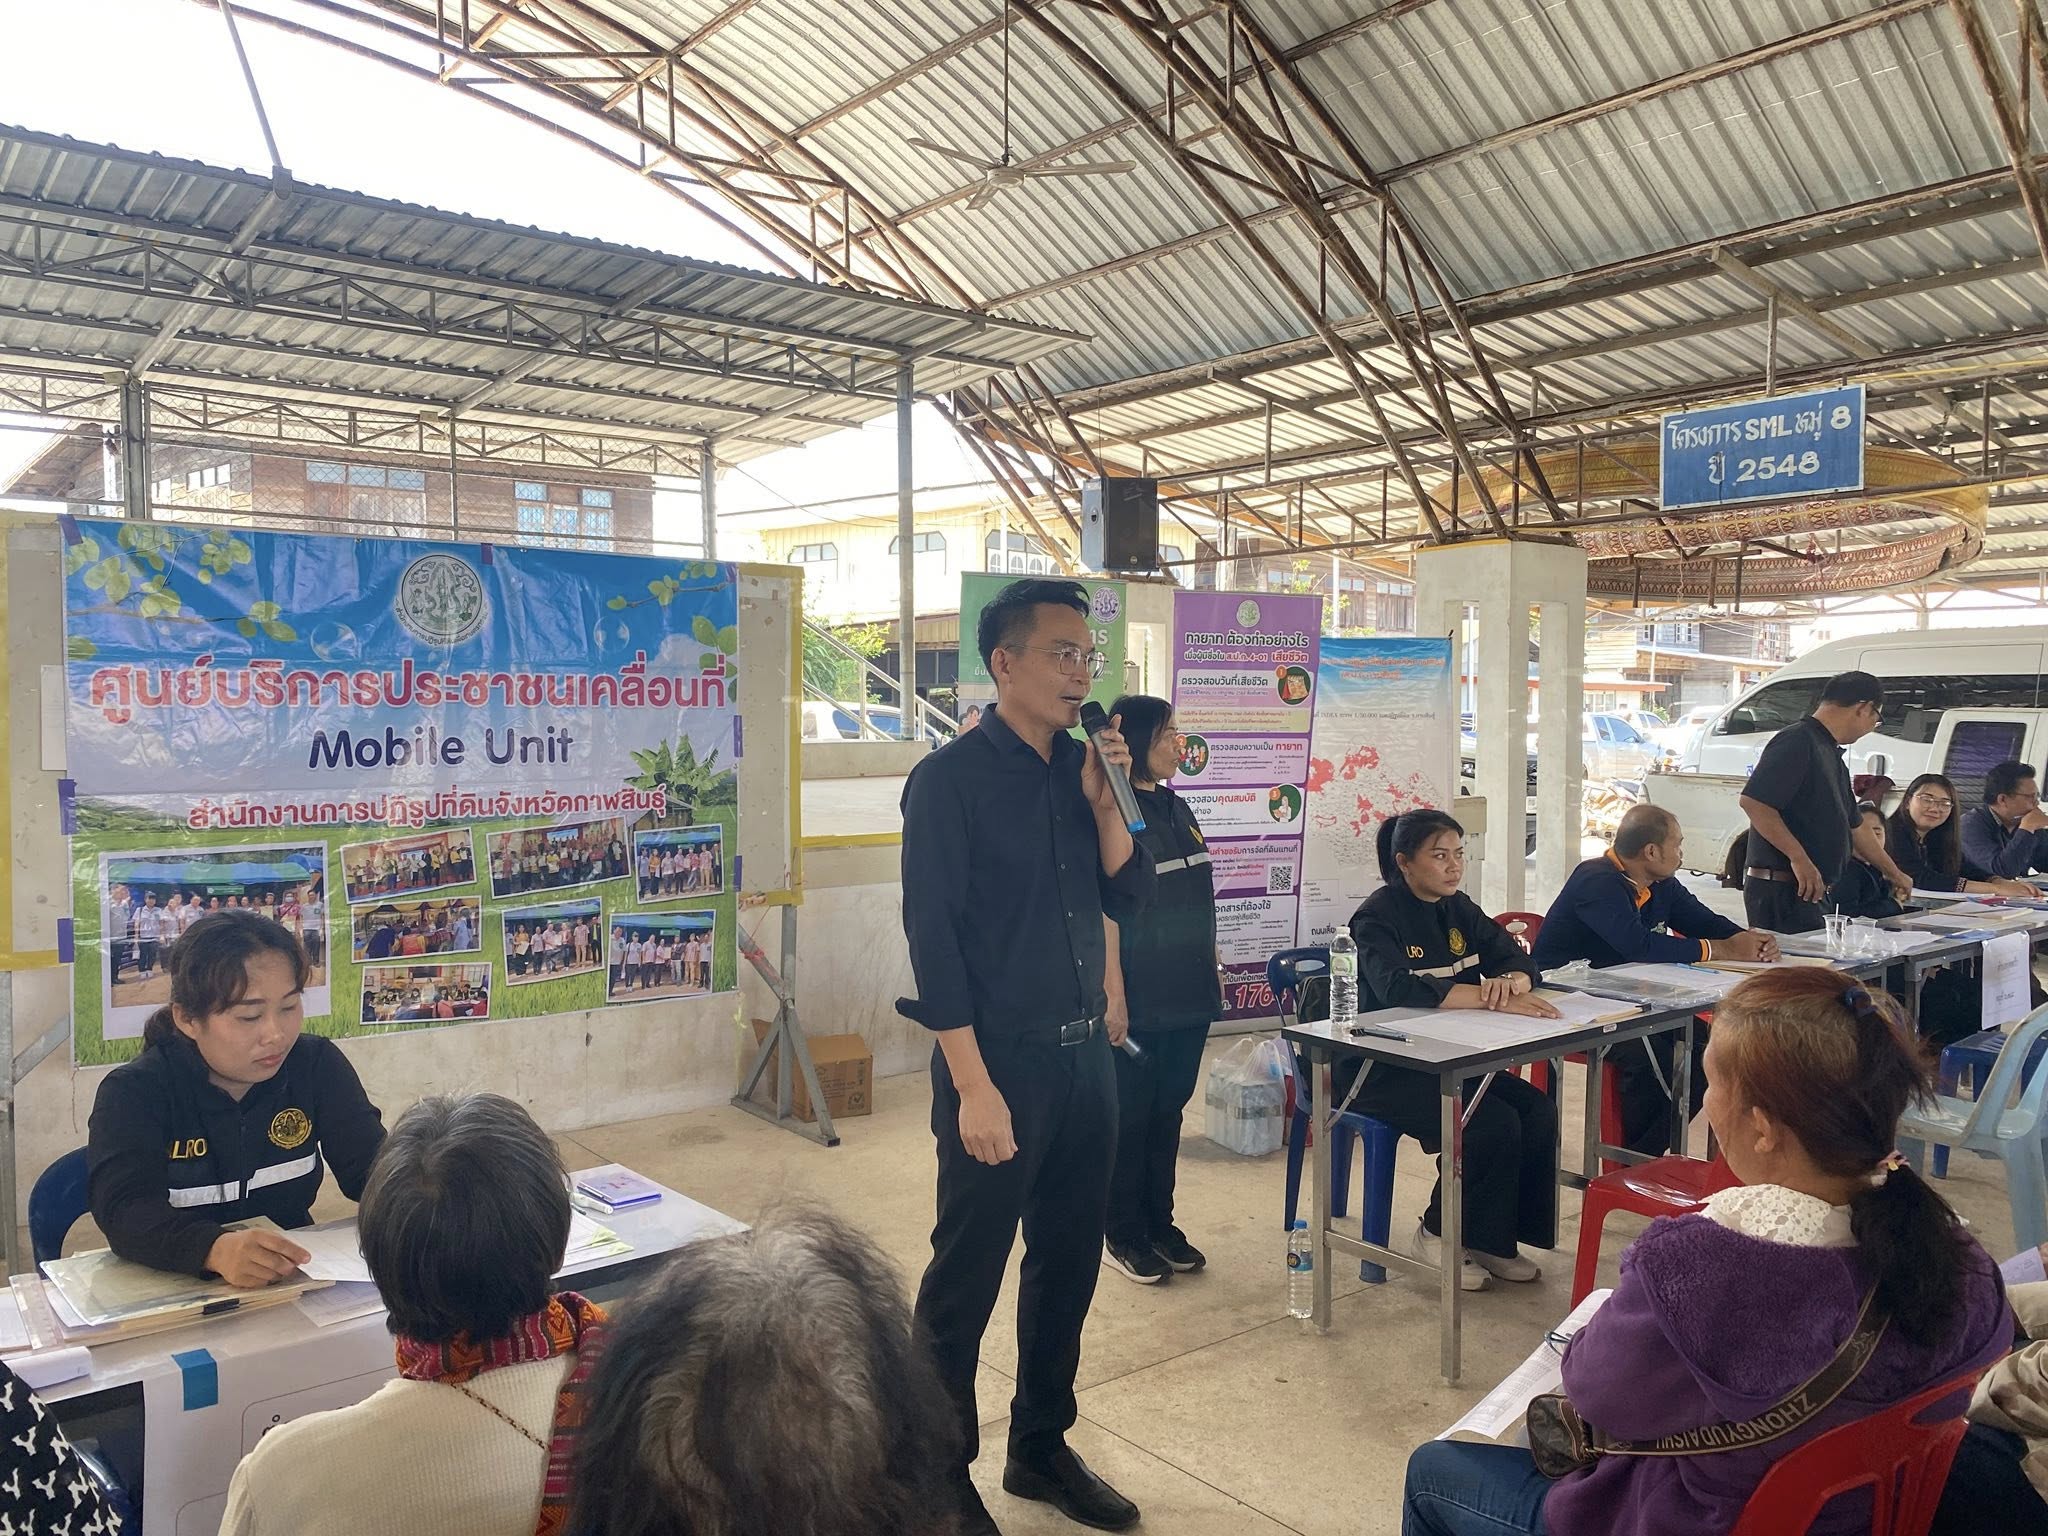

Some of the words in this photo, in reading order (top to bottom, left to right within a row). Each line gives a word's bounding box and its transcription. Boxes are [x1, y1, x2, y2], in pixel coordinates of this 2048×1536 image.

[1667, 418, 1742, 450] โครงการ
[1745, 415, 1793, 441] SML
[1795, 400, 1823, 441] หมู่
[1830, 405, 1851, 430] 8
[1708, 451, 1725, 484] ปี
[1736, 451, 1820, 483] 2548
[1185, 631, 1224, 645] ทายาท
[1226, 630, 1309, 647] ต้องทำอย่างไร
[1272, 650, 1308, 662] เสียชีวิต
[91, 650, 726, 724] ศูนย์บริการประชาชนเคลื่อนที่
[1181, 674, 1268, 686] ตรวจสอบวันที่เสียชีวิต
[309, 726, 464, 769] Mobile
[486, 726, 573, 765] Unit
[1276, 743, 1303, 751] ทายาท
[187, 784, 666, 828] สำนักงานการปฏิรูปที่ดินจังหวัดกาฬสินธุ์
[1208, 843, 1298, 855] นคำขอรับการจัดที่ดินแทนที่
[1215, 900, 1271, 912] อกสารที่ต้องใช้
[1236, 983, 1287, 1009] 176
[171, 1138, 207, 1159] LRO
